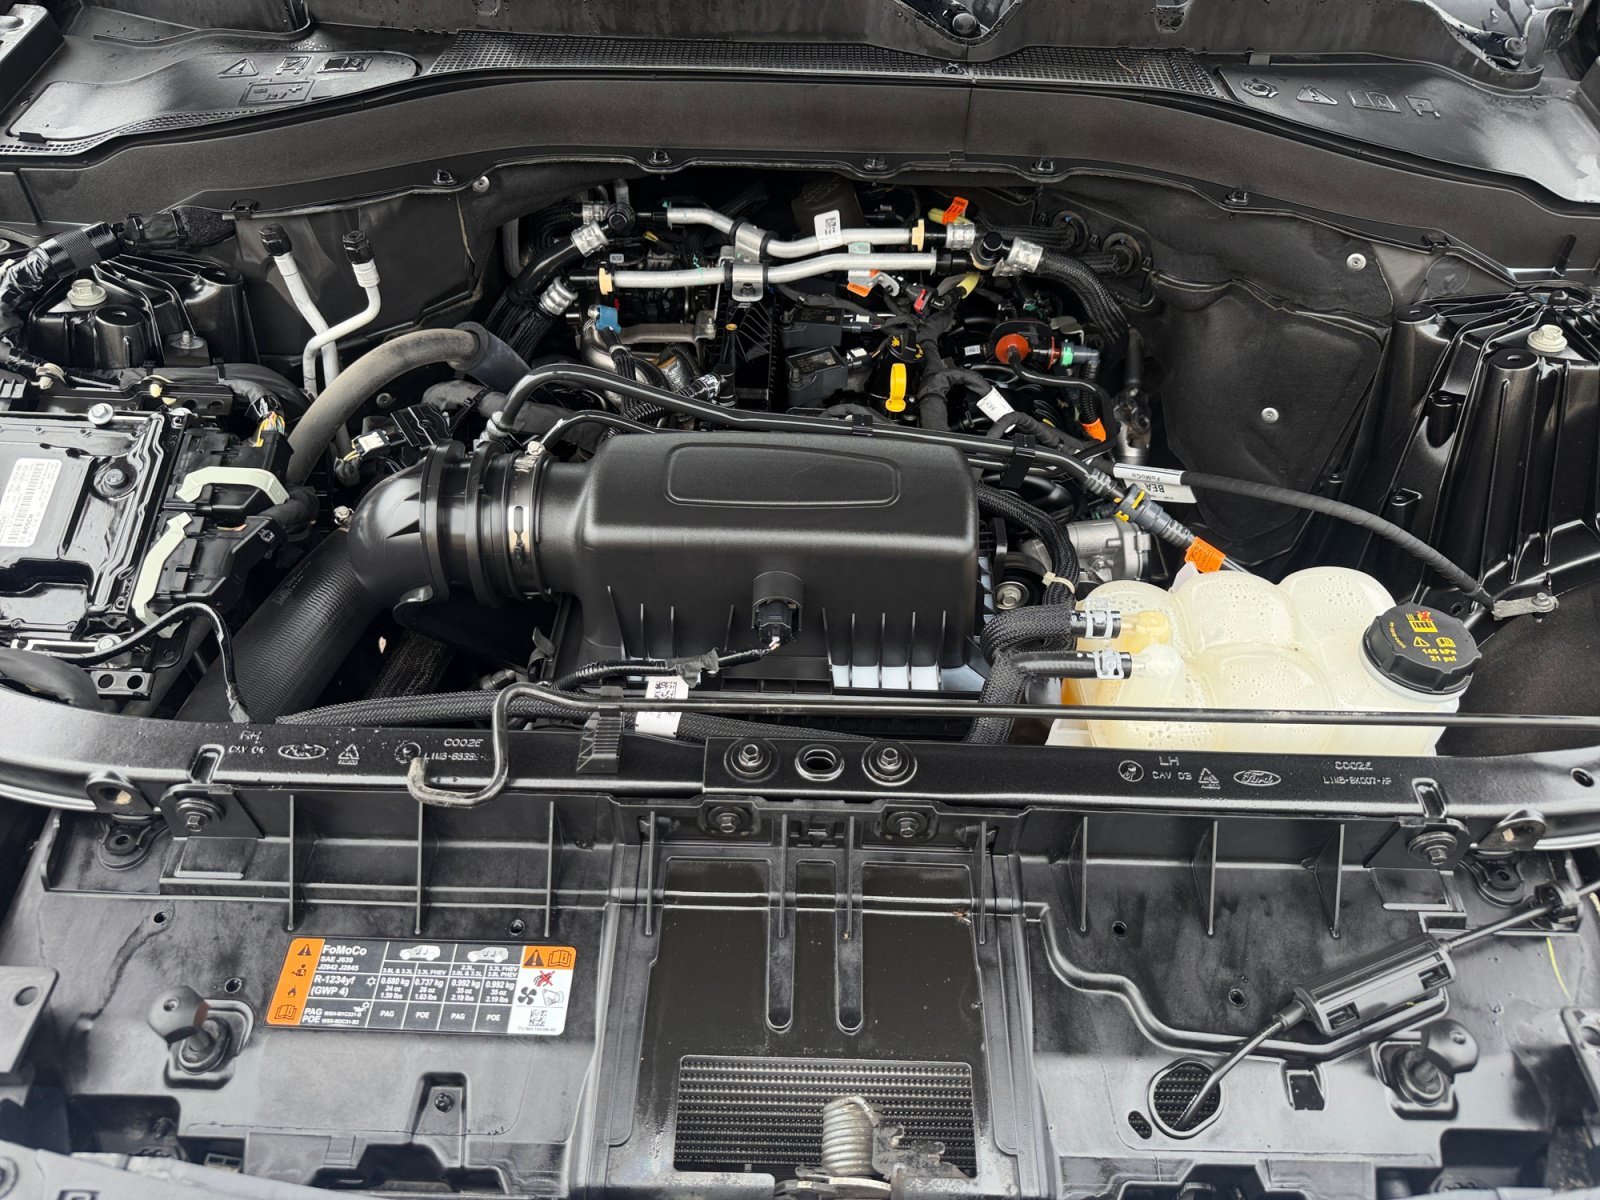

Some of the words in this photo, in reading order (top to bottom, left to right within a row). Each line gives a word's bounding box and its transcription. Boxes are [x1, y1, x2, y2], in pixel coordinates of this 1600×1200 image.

[1144, 482, 1165, 493] BEA
[1158, 756, 1180, 766] LH
[1152, 771, 1172, 779] CAV
[322, 944, 367, 955] FoMoCo
[314, 975, 356, 986] R-1234yf
[400, 979, 410, 987] kg
[434, 979, 444, 988] kg
[471, 980, 481, 989] kg
[505, 982, 515, 990] kg
[311, 986, 338, 996] (GWP
[339, 987, 348, 997] 4)
